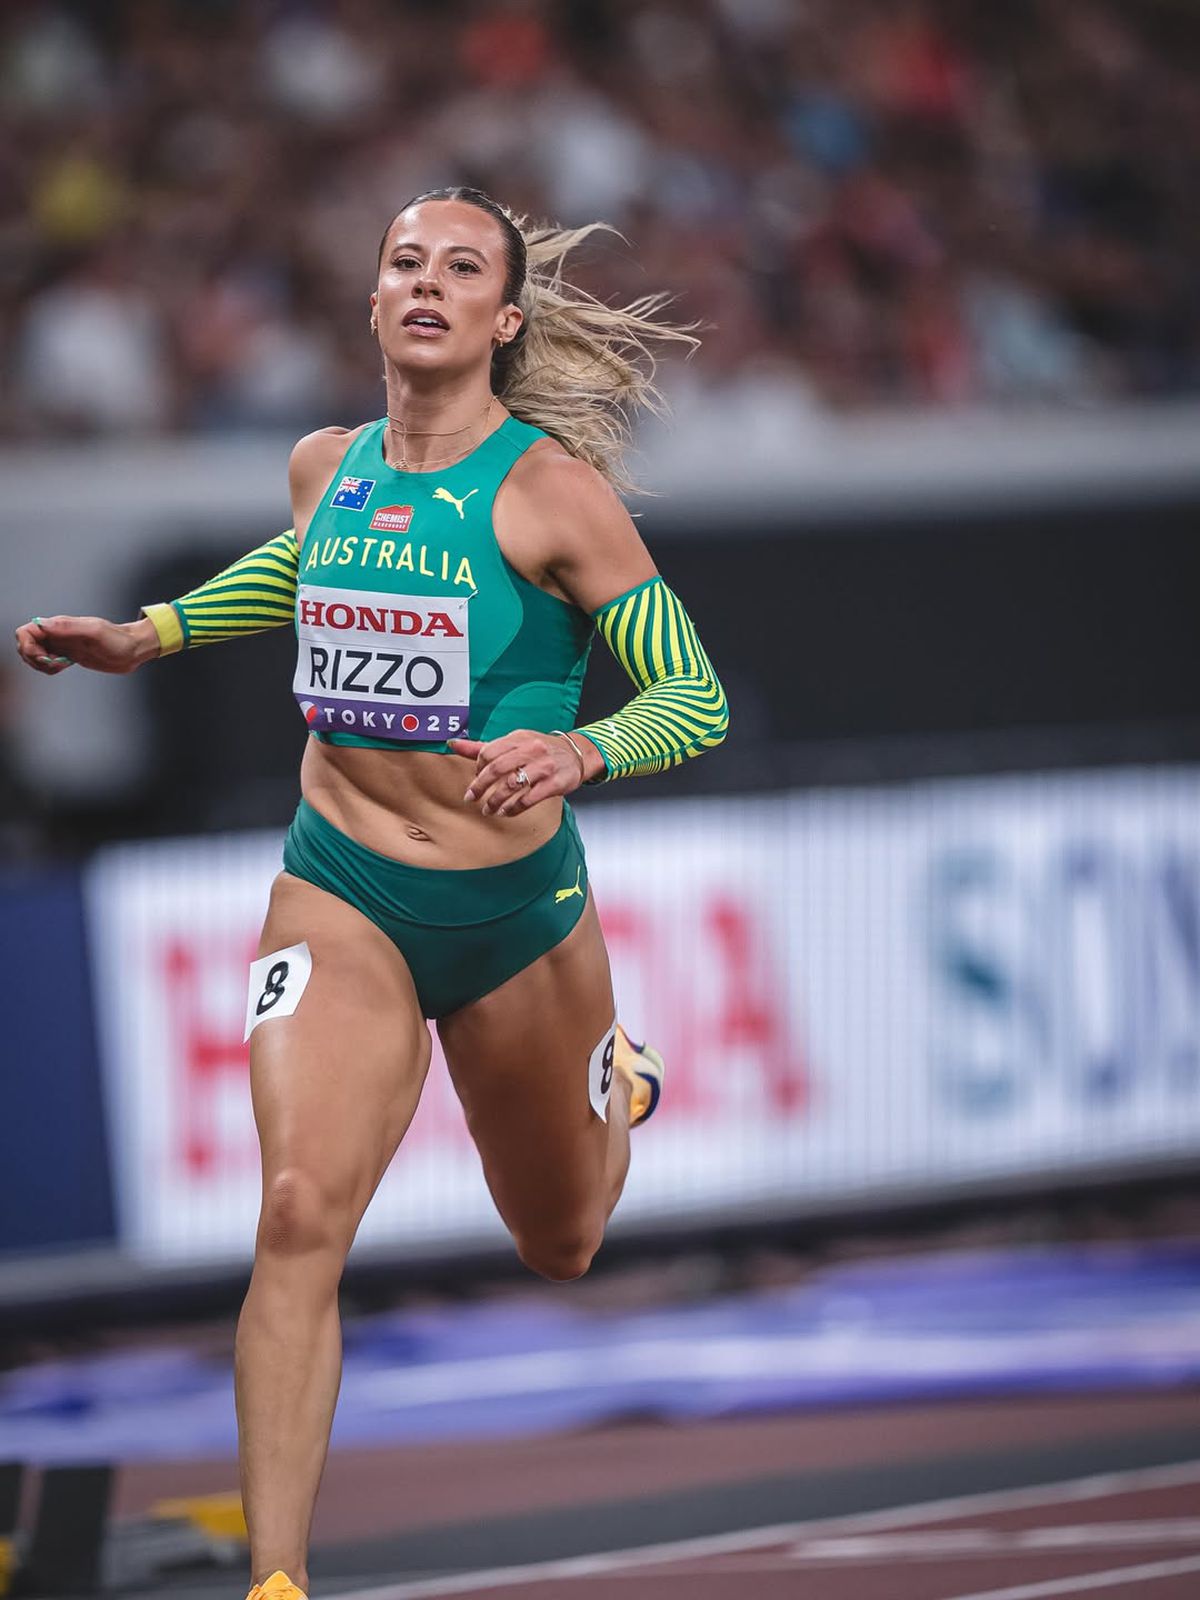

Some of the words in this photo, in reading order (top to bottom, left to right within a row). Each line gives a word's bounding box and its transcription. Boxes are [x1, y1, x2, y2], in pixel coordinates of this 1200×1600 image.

[375, 512, 410, 524] CHEMIST
[305, 536, 478, 590] AUSTRALIA
[300, 599, 464, 638] HONDA
[310, 646, 444, 699] RIZZO
[427, 715, 460, 732] 25
[256, 960, 289, 1016] 8
[601, 1034, 615, 1095] 8
